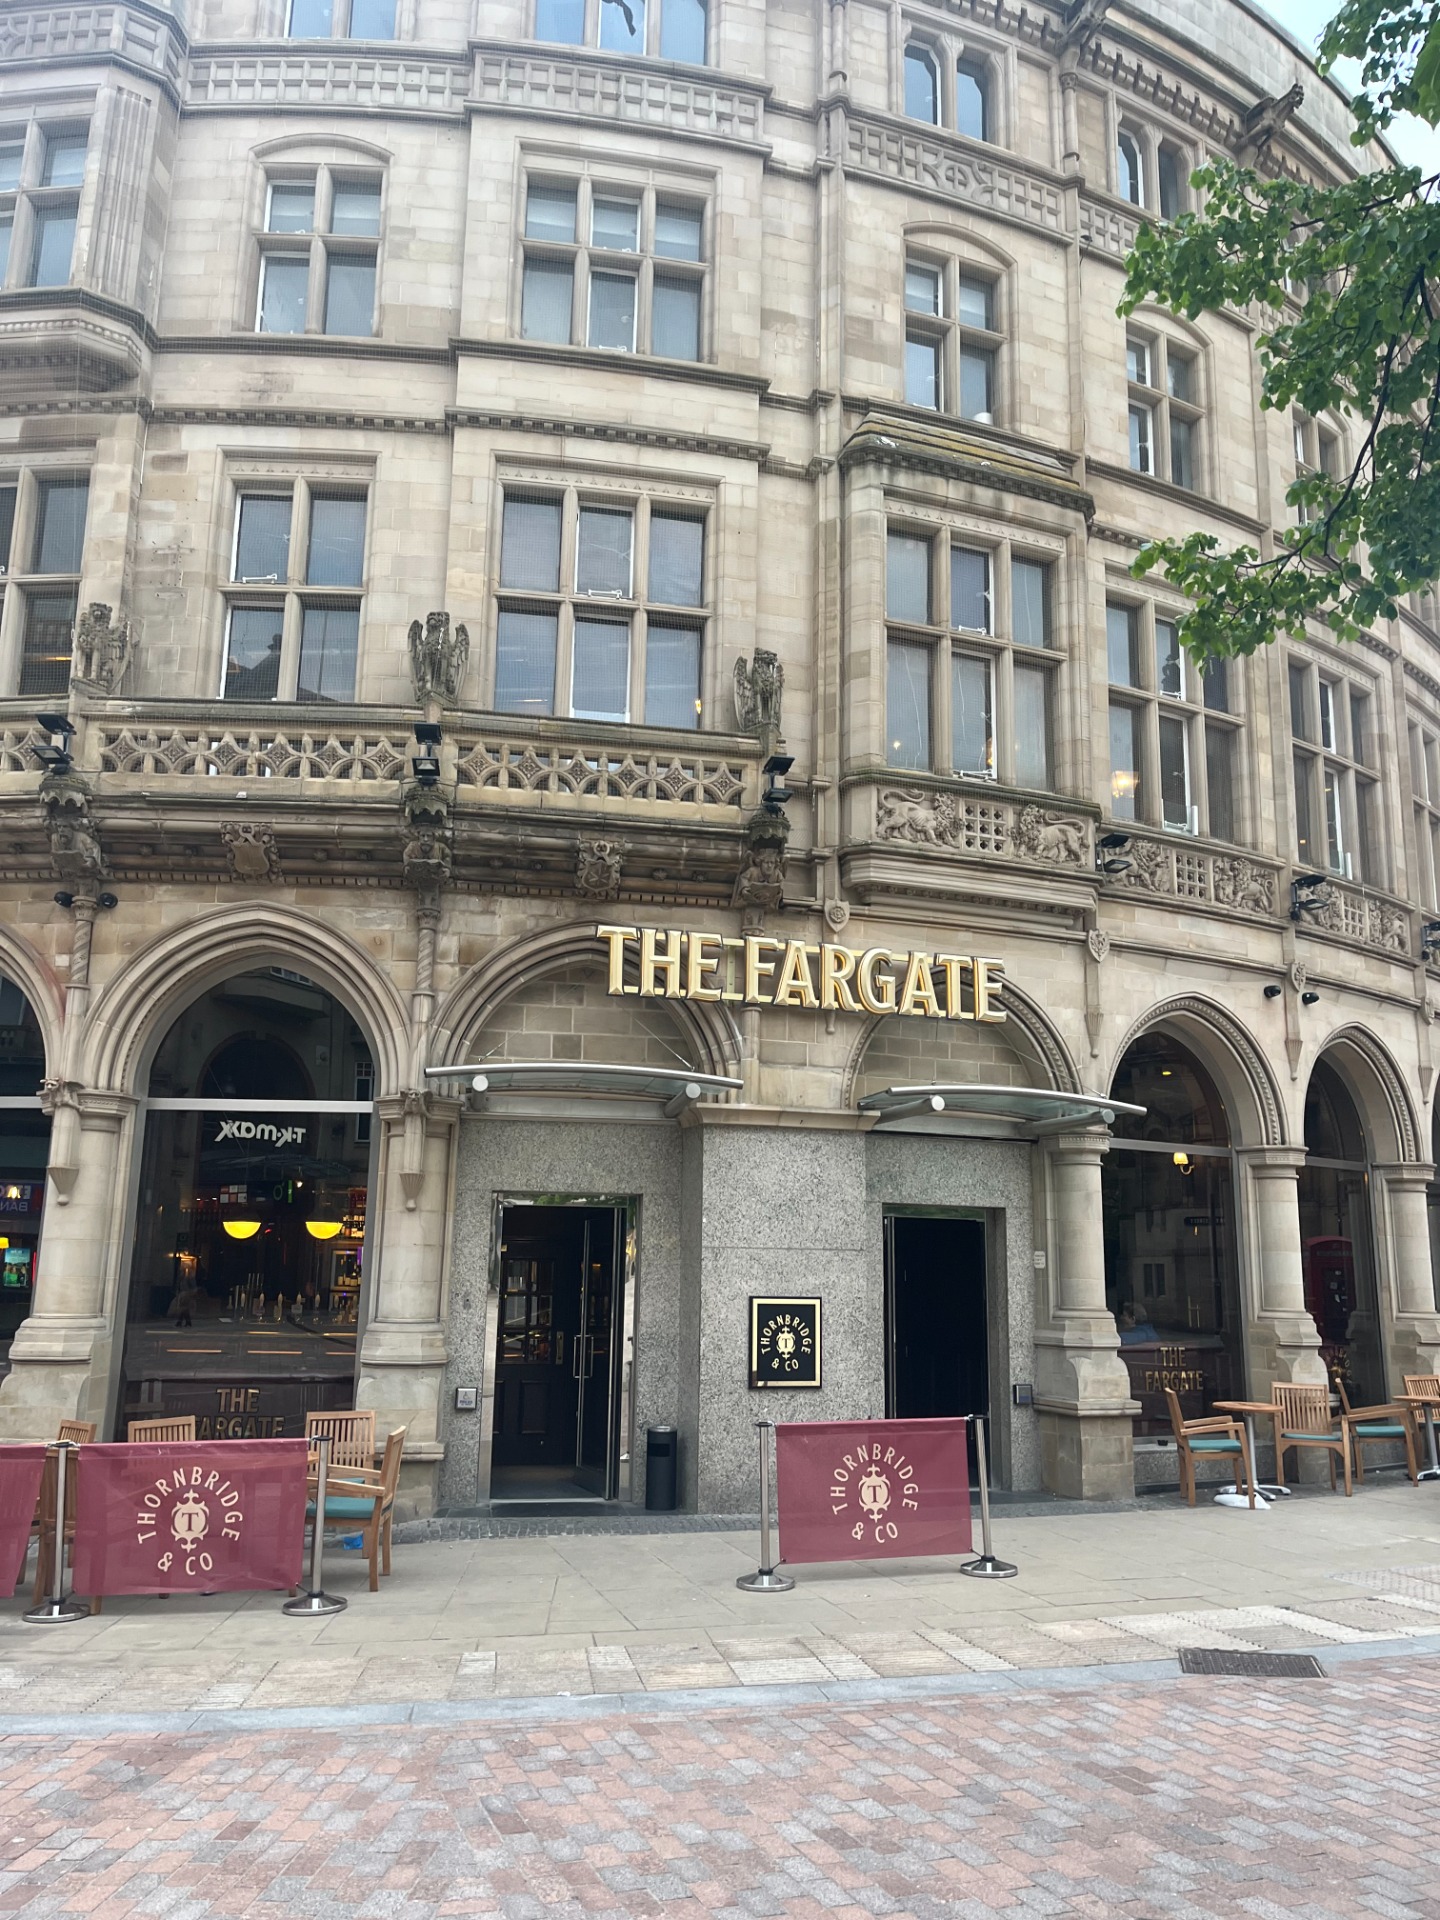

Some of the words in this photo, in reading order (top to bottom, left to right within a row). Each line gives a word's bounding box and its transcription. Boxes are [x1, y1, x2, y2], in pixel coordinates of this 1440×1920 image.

[597, 925, 723, 1001] THE
[744, 935, 1008, 1022] FARGATE
[760, 1314, 812, 1355] THORNBRIDGE
[771, 1358, 780, 1369] &
[785, 1359, 799, 1372] CO
[1160, 1347, 1187, 1367] THE
[1145, 1370, 1204, 1391] FARGATE
[216, 1388, 260, 1412] THE
[195, 1416, 284, 1440] ARGATE
[830, 1443, 919, 1516] THORNBRIDGE
[137, 1466, 243, 1544] THORNBRIDGE
[851, 1522, 864, 1540] &
[875, 1522, 898, 1543] CO
[157, 1552, 173, 1572] &
[185, 1552, 213, 1575] CO
